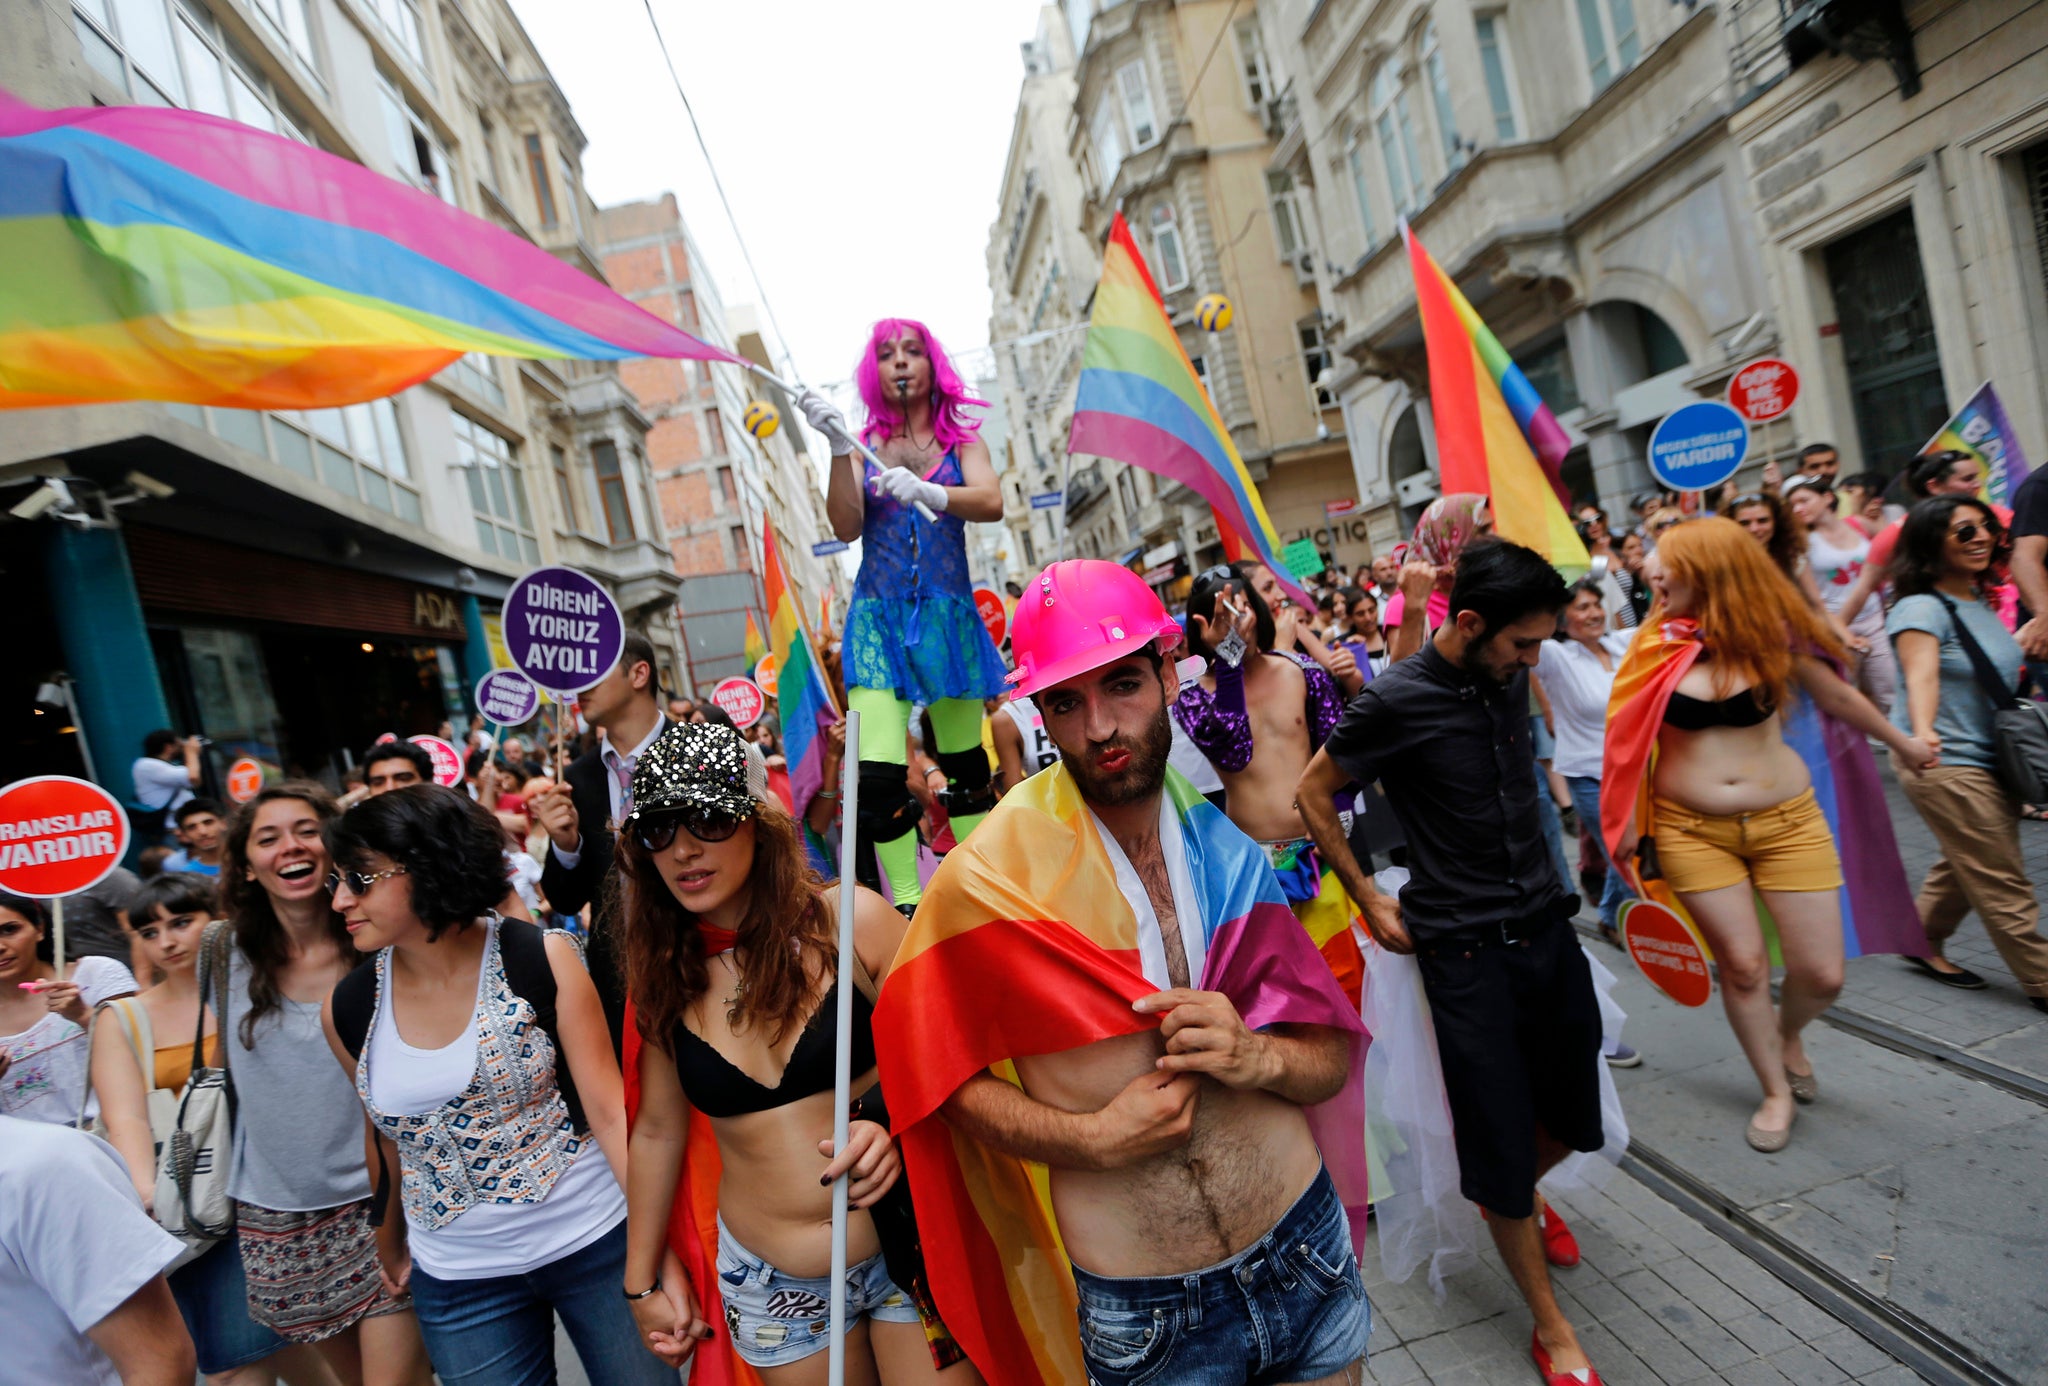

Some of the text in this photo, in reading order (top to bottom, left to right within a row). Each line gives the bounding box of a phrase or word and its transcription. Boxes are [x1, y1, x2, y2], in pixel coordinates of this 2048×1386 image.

[1664, 442, 1735, 471] VARDIR
[415, 592, 465, 631] ADA
[527, 582, 606, 616] DİRENİ-
[525, 612, 600, 644] YORUZ
[525, 643, 598, 675] AYOL!
[716, 685, 752, 704] GENEL
[0, 809, 114, 841] RANSLAR
